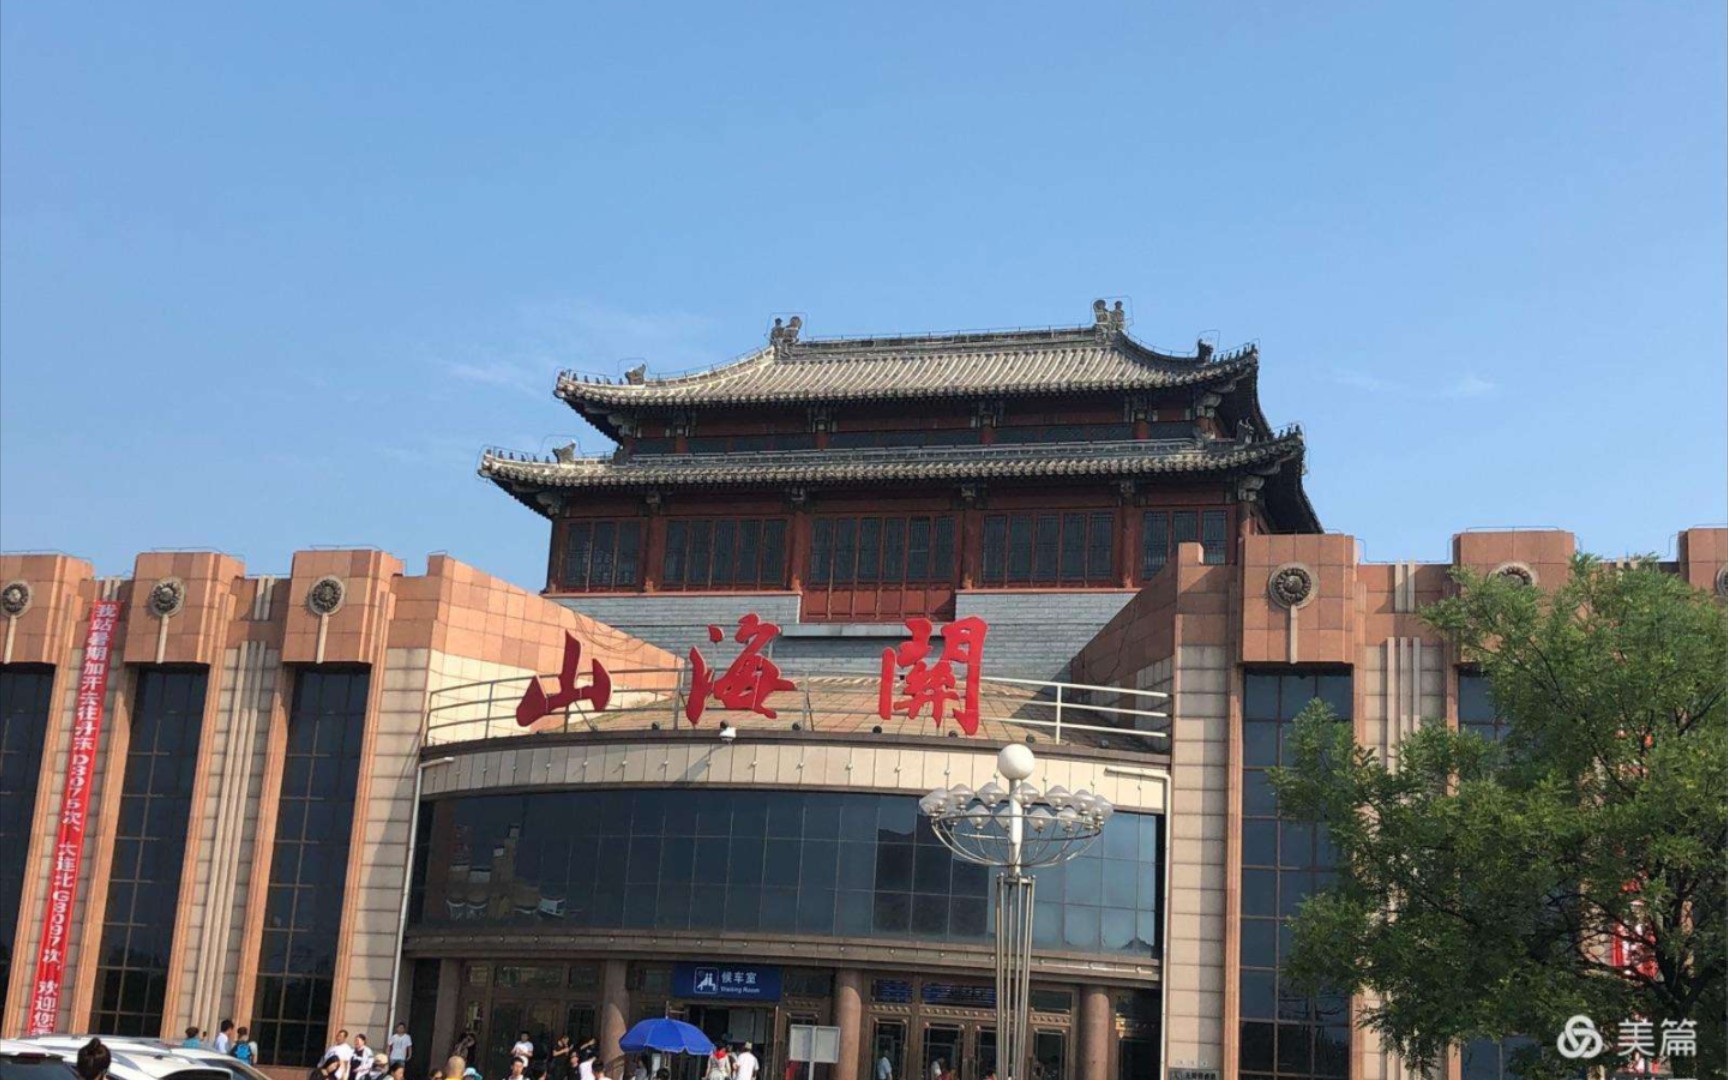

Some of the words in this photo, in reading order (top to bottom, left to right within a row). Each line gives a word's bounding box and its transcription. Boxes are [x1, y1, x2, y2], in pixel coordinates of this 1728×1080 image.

[721, 971, 757, 984] 候车室
[720, 986, 742, 994] Waiting
